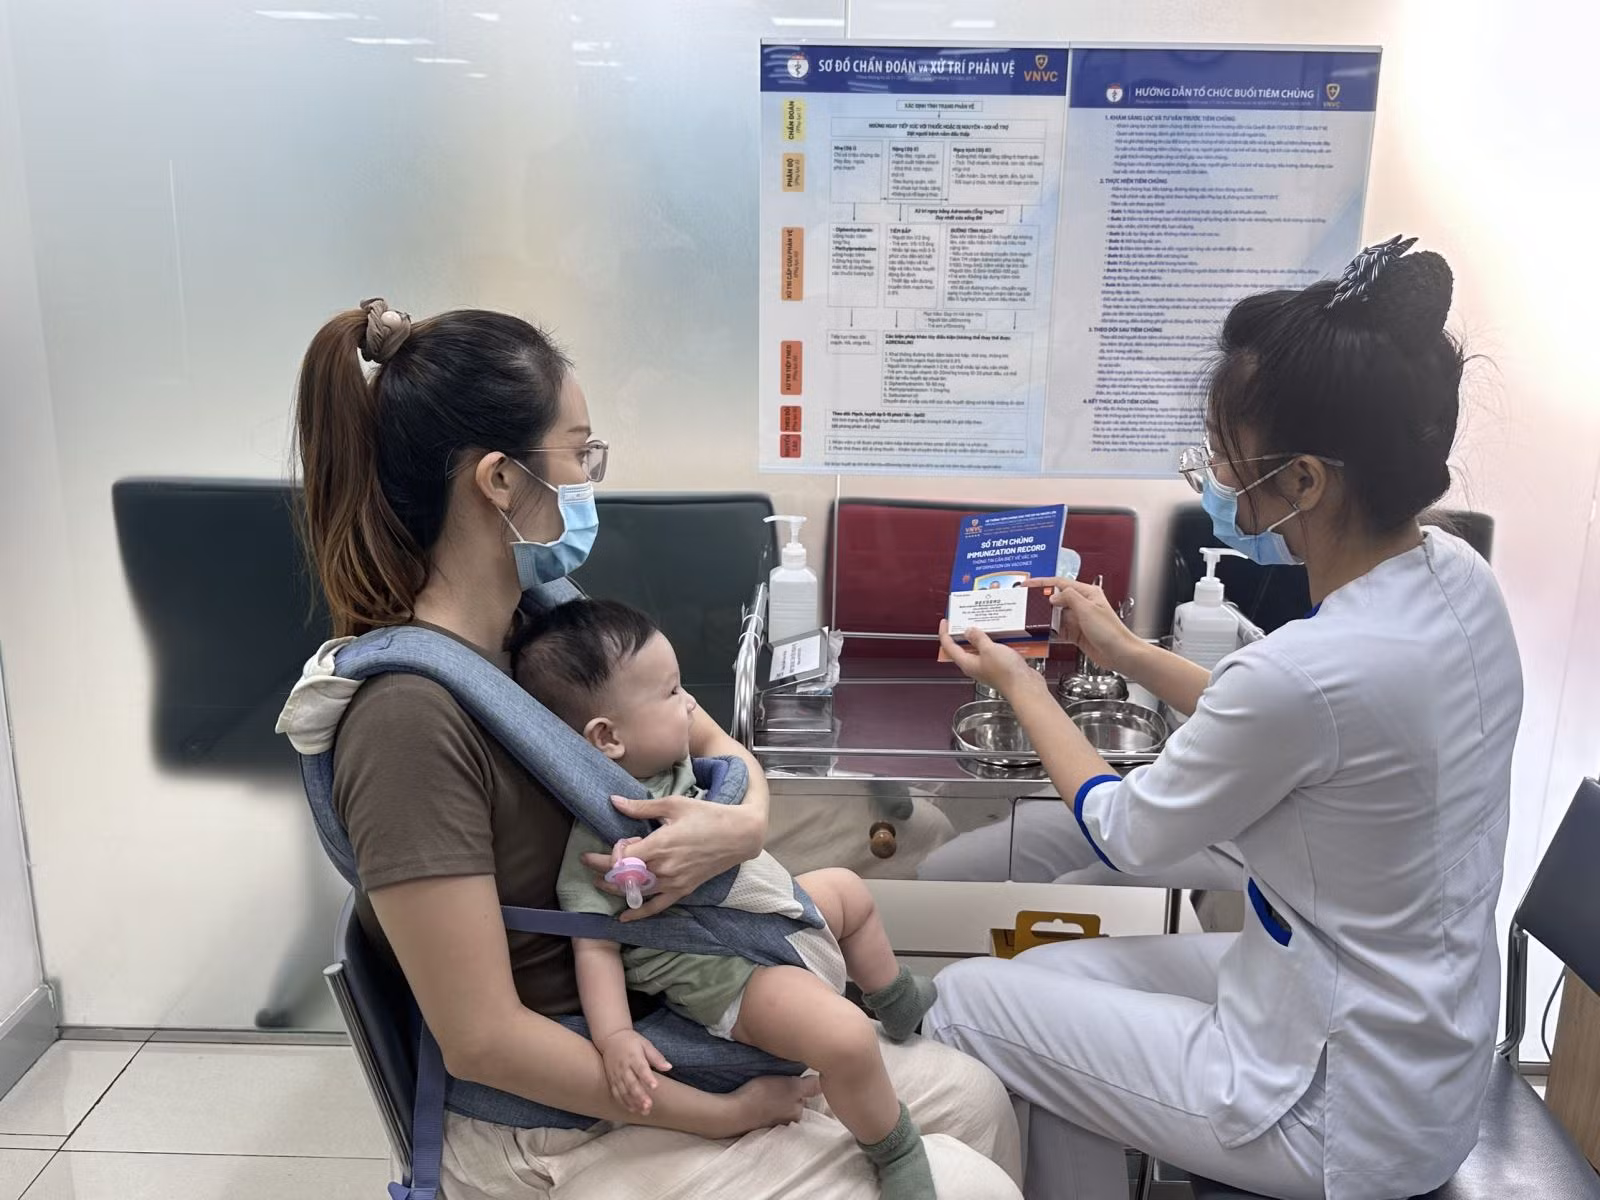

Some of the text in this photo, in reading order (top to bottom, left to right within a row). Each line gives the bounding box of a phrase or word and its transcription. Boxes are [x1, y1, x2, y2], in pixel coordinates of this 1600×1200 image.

[818, 58, 833, 72] SƠ
[886, 58, 916, 73] ĐOÁN
[930, 58, 946, 74] XỬ
[947, 58, 966, 74] TRÍ
[968, 58, 999, 74] PHẢN
[1002, 59, 1015, 78] VỆ
[1024, 71, 1058, 82] VNVC
[1135, 86, 1170, 97] HƯỚNG
[1207, 86, 1233, 98] CHỨC
[1234, 86, 1256, 98] BUỔI
[1258, 87, 1279, 98] TIÊM
[1281, 87, 1314, 98] CHỦNG
[992, 539, 1008, 547] TIÊM
[1009, 536, 1034, 545] CHỦNG
[967, 544, 1046, 559] IMMUNIZATION RECORD
